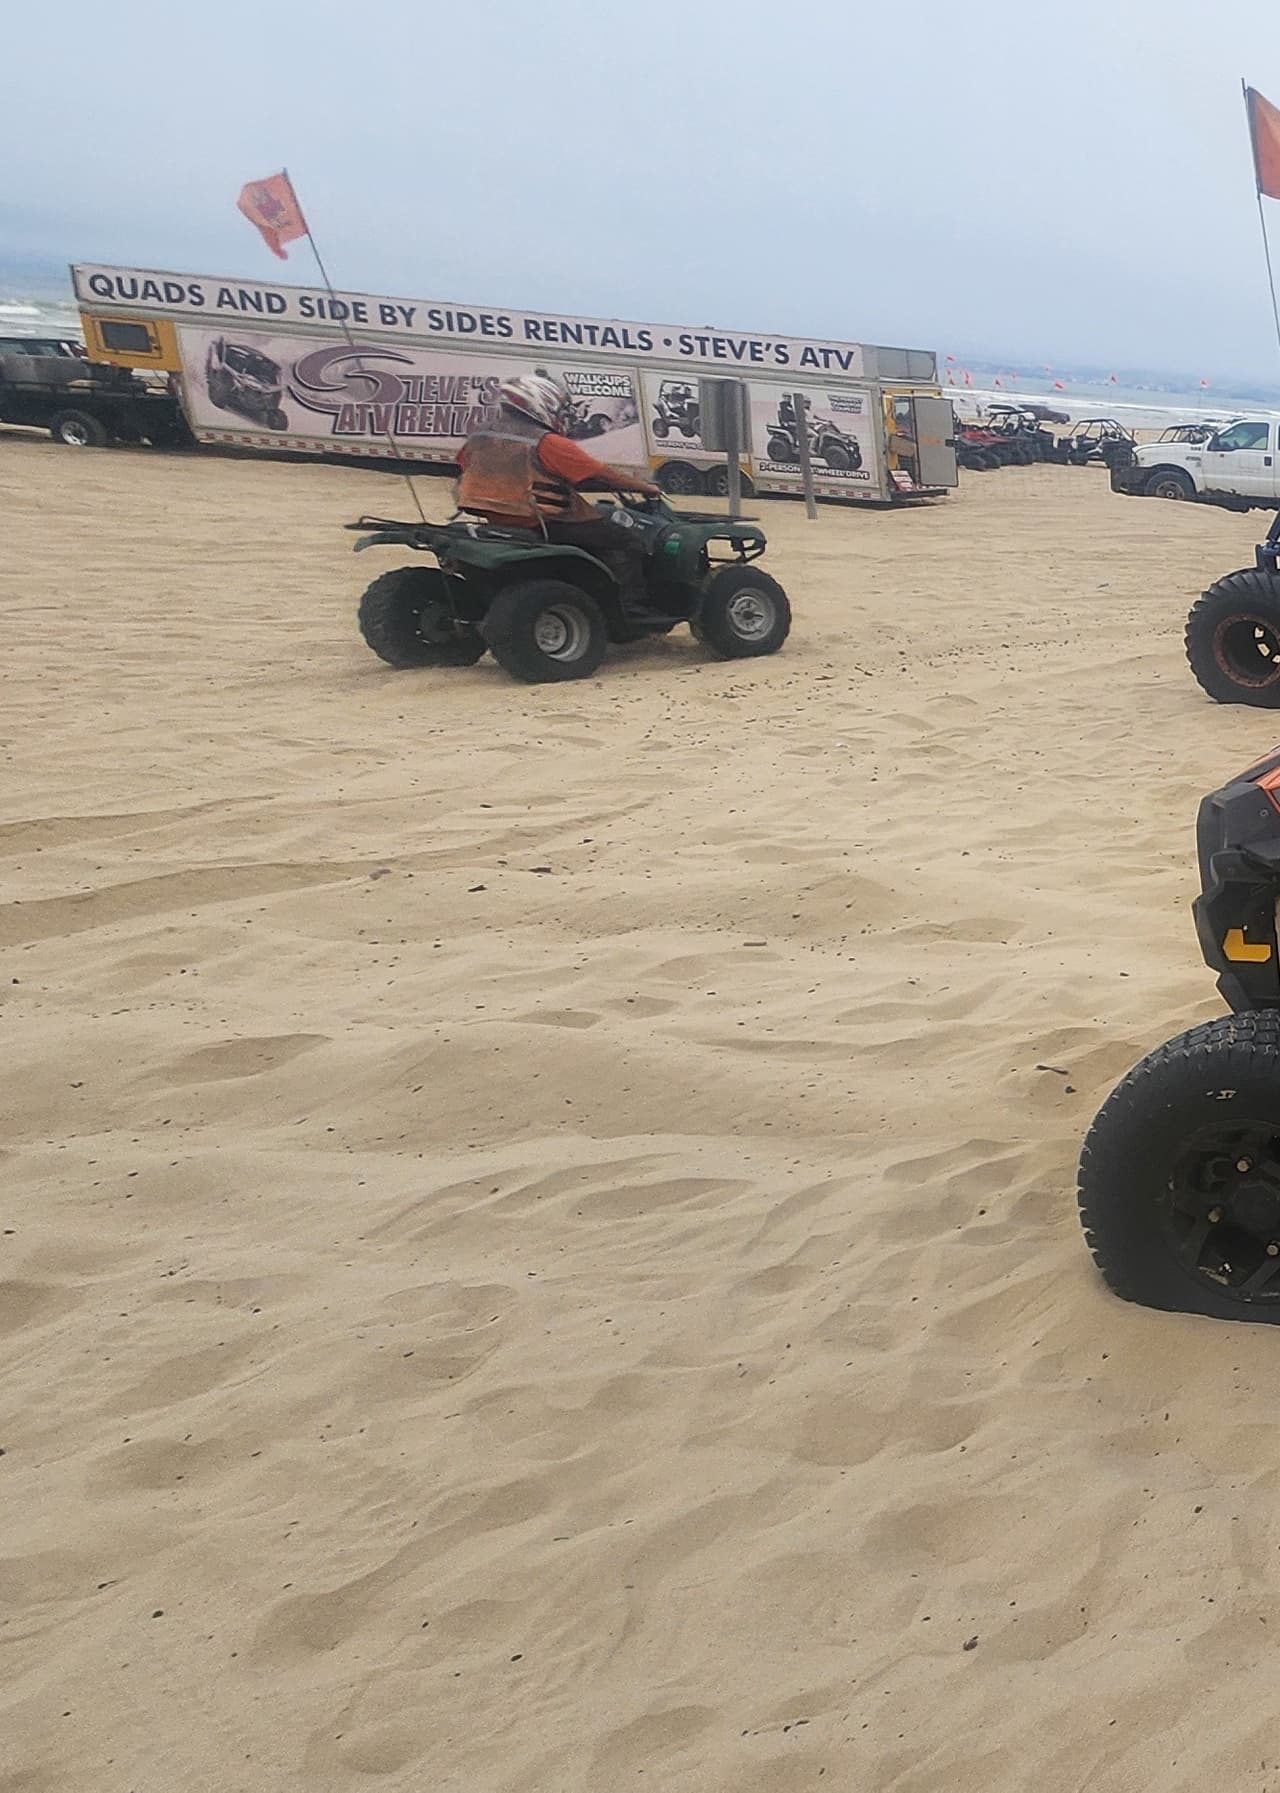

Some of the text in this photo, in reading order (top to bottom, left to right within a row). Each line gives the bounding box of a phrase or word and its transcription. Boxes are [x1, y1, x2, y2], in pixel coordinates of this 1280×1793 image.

[89, 274, 854, 370] QUADS AND SIDE BY SIDES RENTALS STEVE'S ATV
[564, 373, 631, 386] WALK-UPS
[567, 383, 632, 397] WELCOME
[333, 403, 394, 435] ATV
